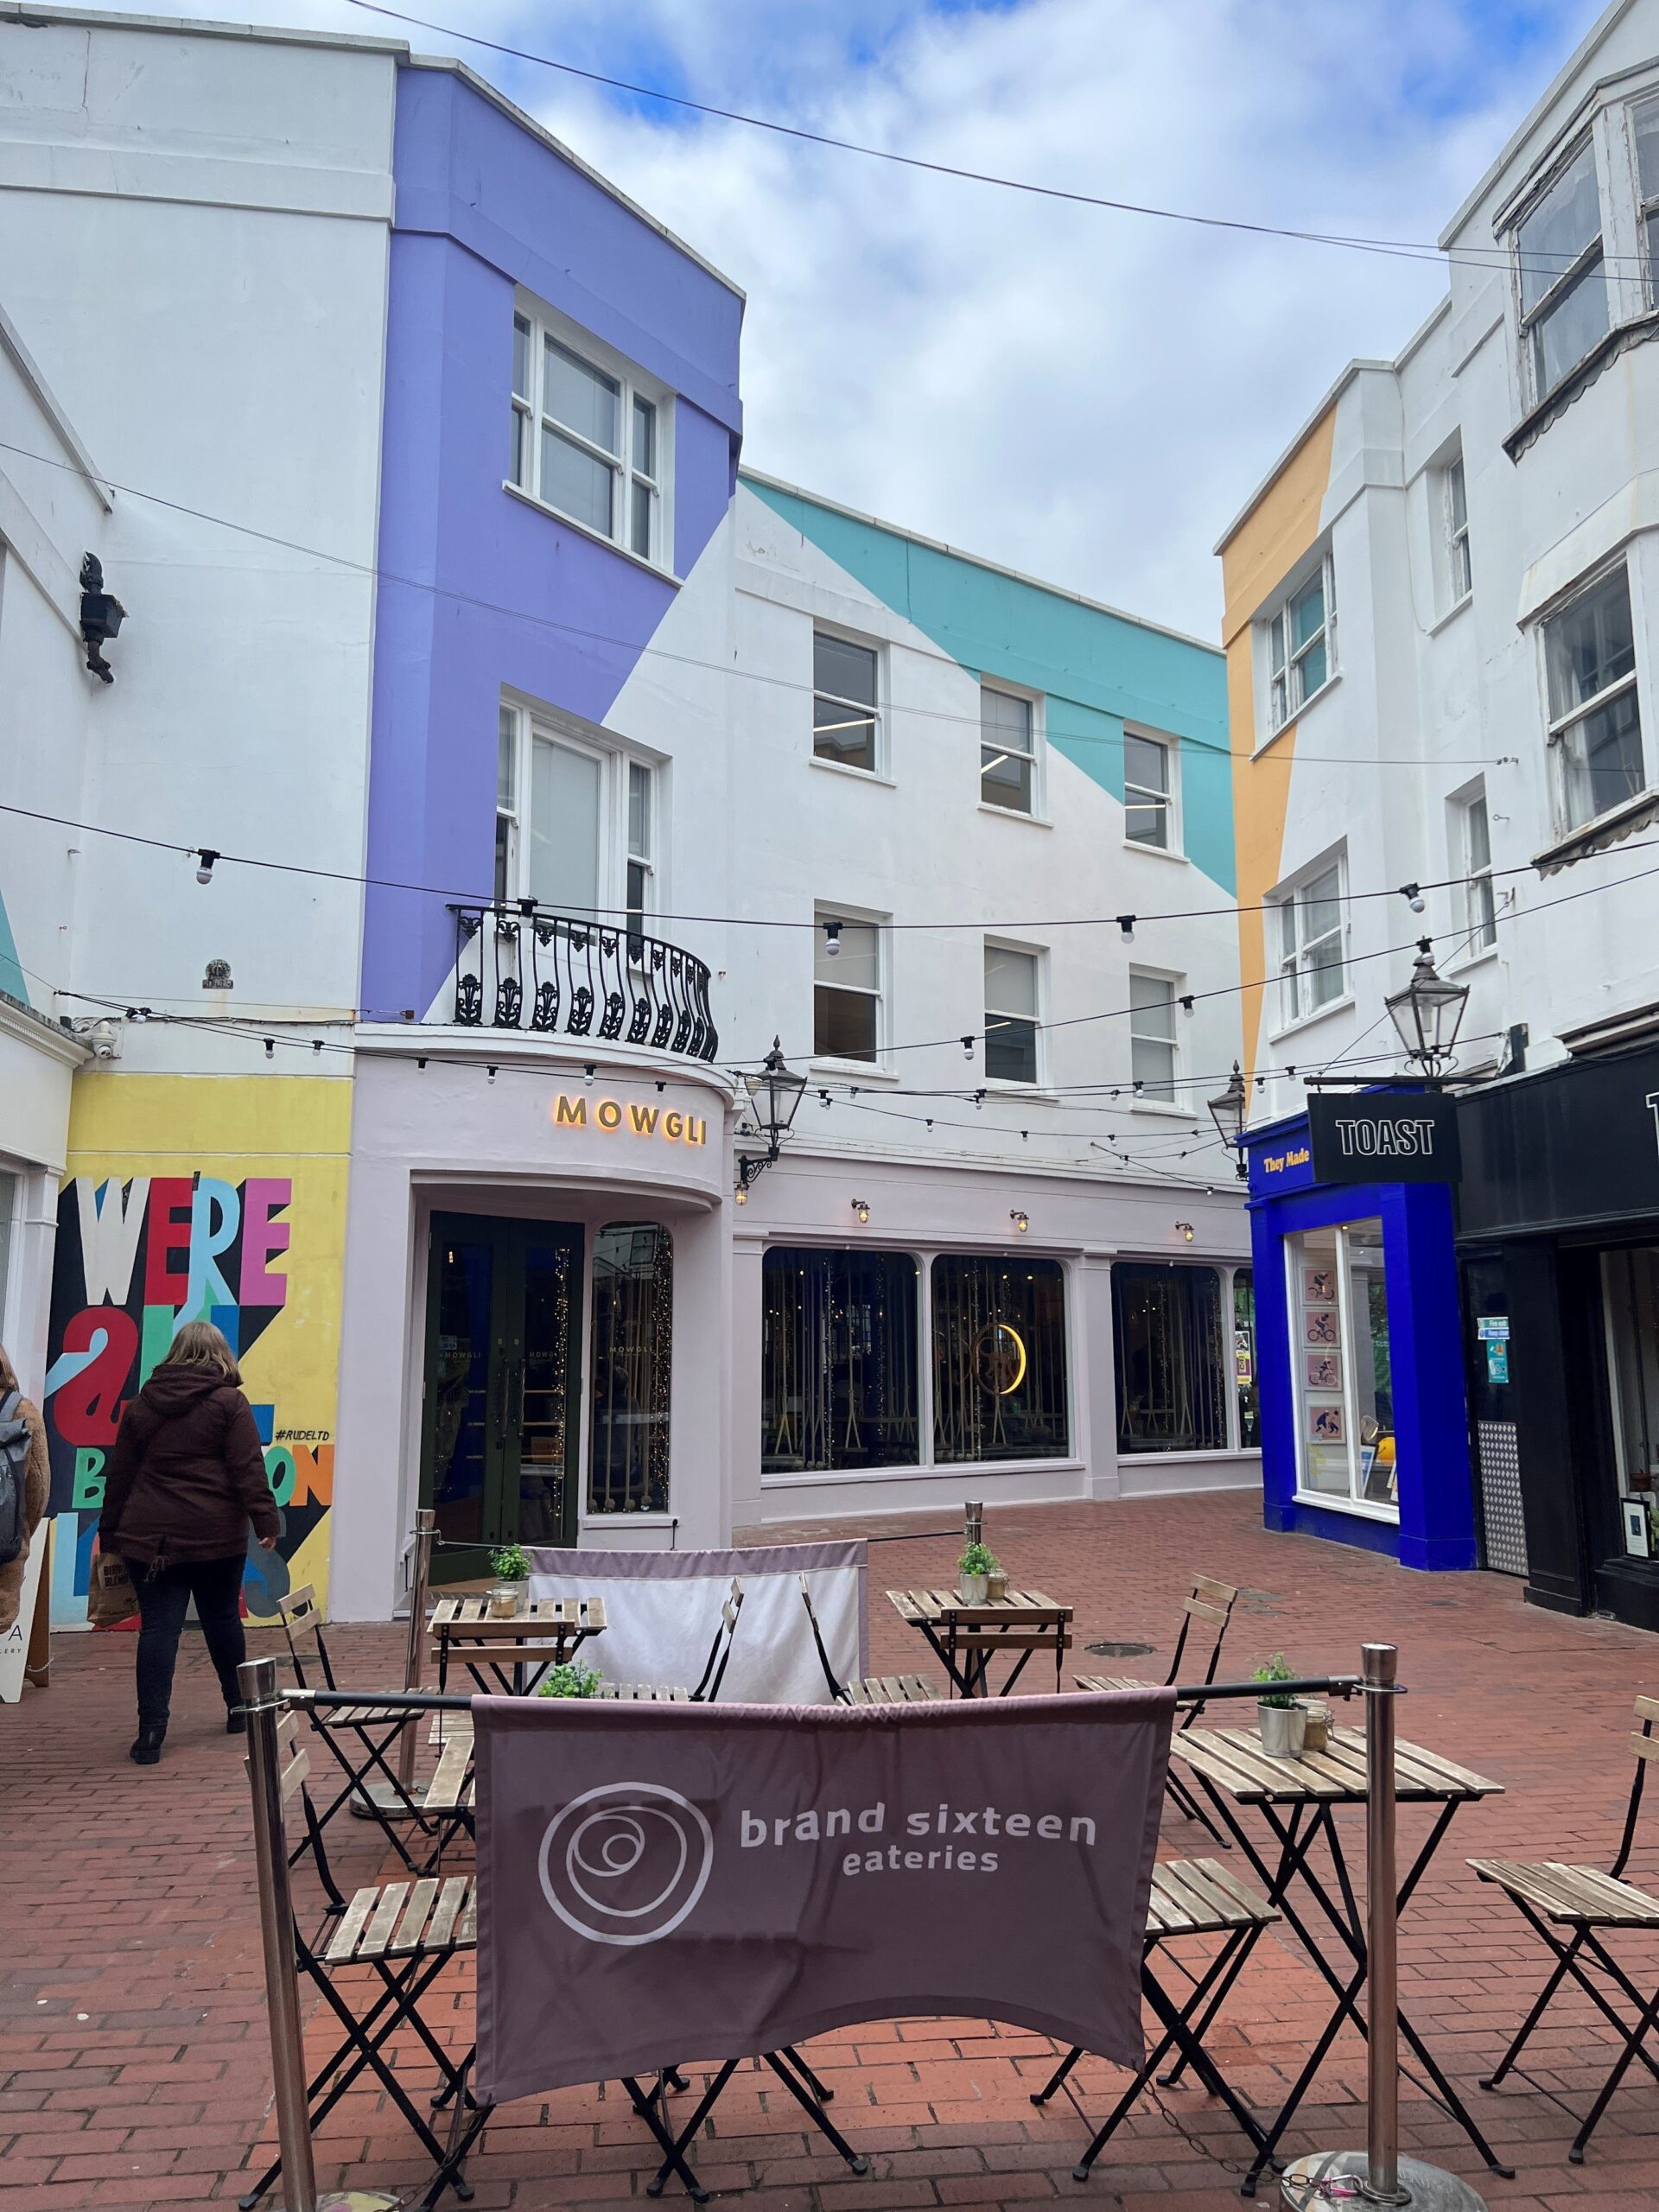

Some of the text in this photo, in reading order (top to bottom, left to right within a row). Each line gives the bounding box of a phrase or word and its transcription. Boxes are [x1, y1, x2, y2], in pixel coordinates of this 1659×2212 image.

[556, 1095, 707, 1145] MOWGLI
[1335, 1119, 1435, 1155] TOAST
[1263, 1147, 1310, 1173] They Made
[76, 1177, 293, 1306] WERE
[276, 1429, 330, 1441] #RUDELTD
[740, 1802, 1096, 1847] brand sixteen
[842, 1845, 999, 1876] eateries
